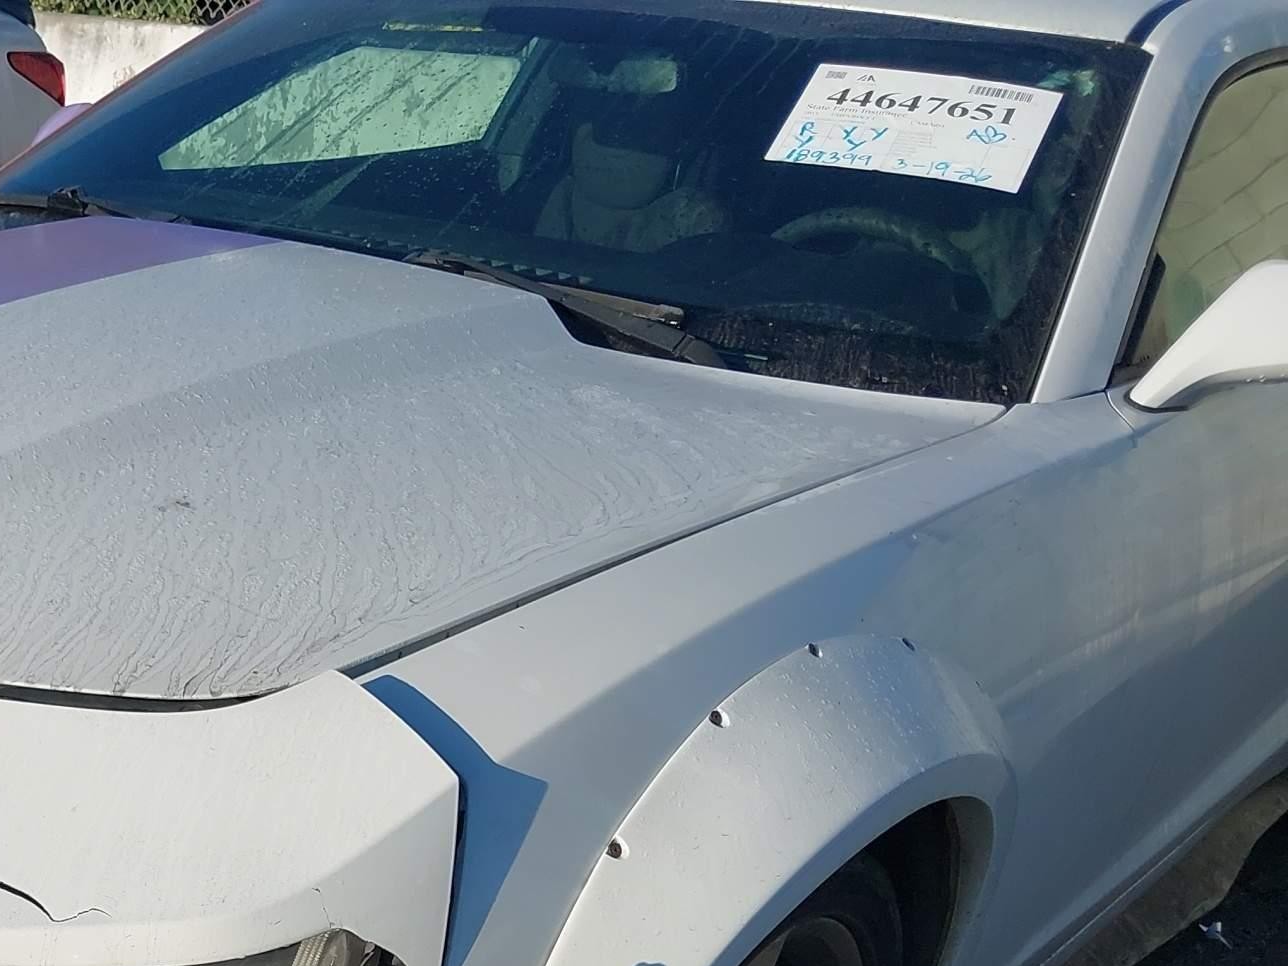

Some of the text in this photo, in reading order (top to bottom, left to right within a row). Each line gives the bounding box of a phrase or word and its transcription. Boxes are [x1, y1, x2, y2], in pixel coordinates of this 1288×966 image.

[807, 103, 831, 111] State
[833, 105, 858, 114] Farm
[826, 87, 1017, 125] 44647651
